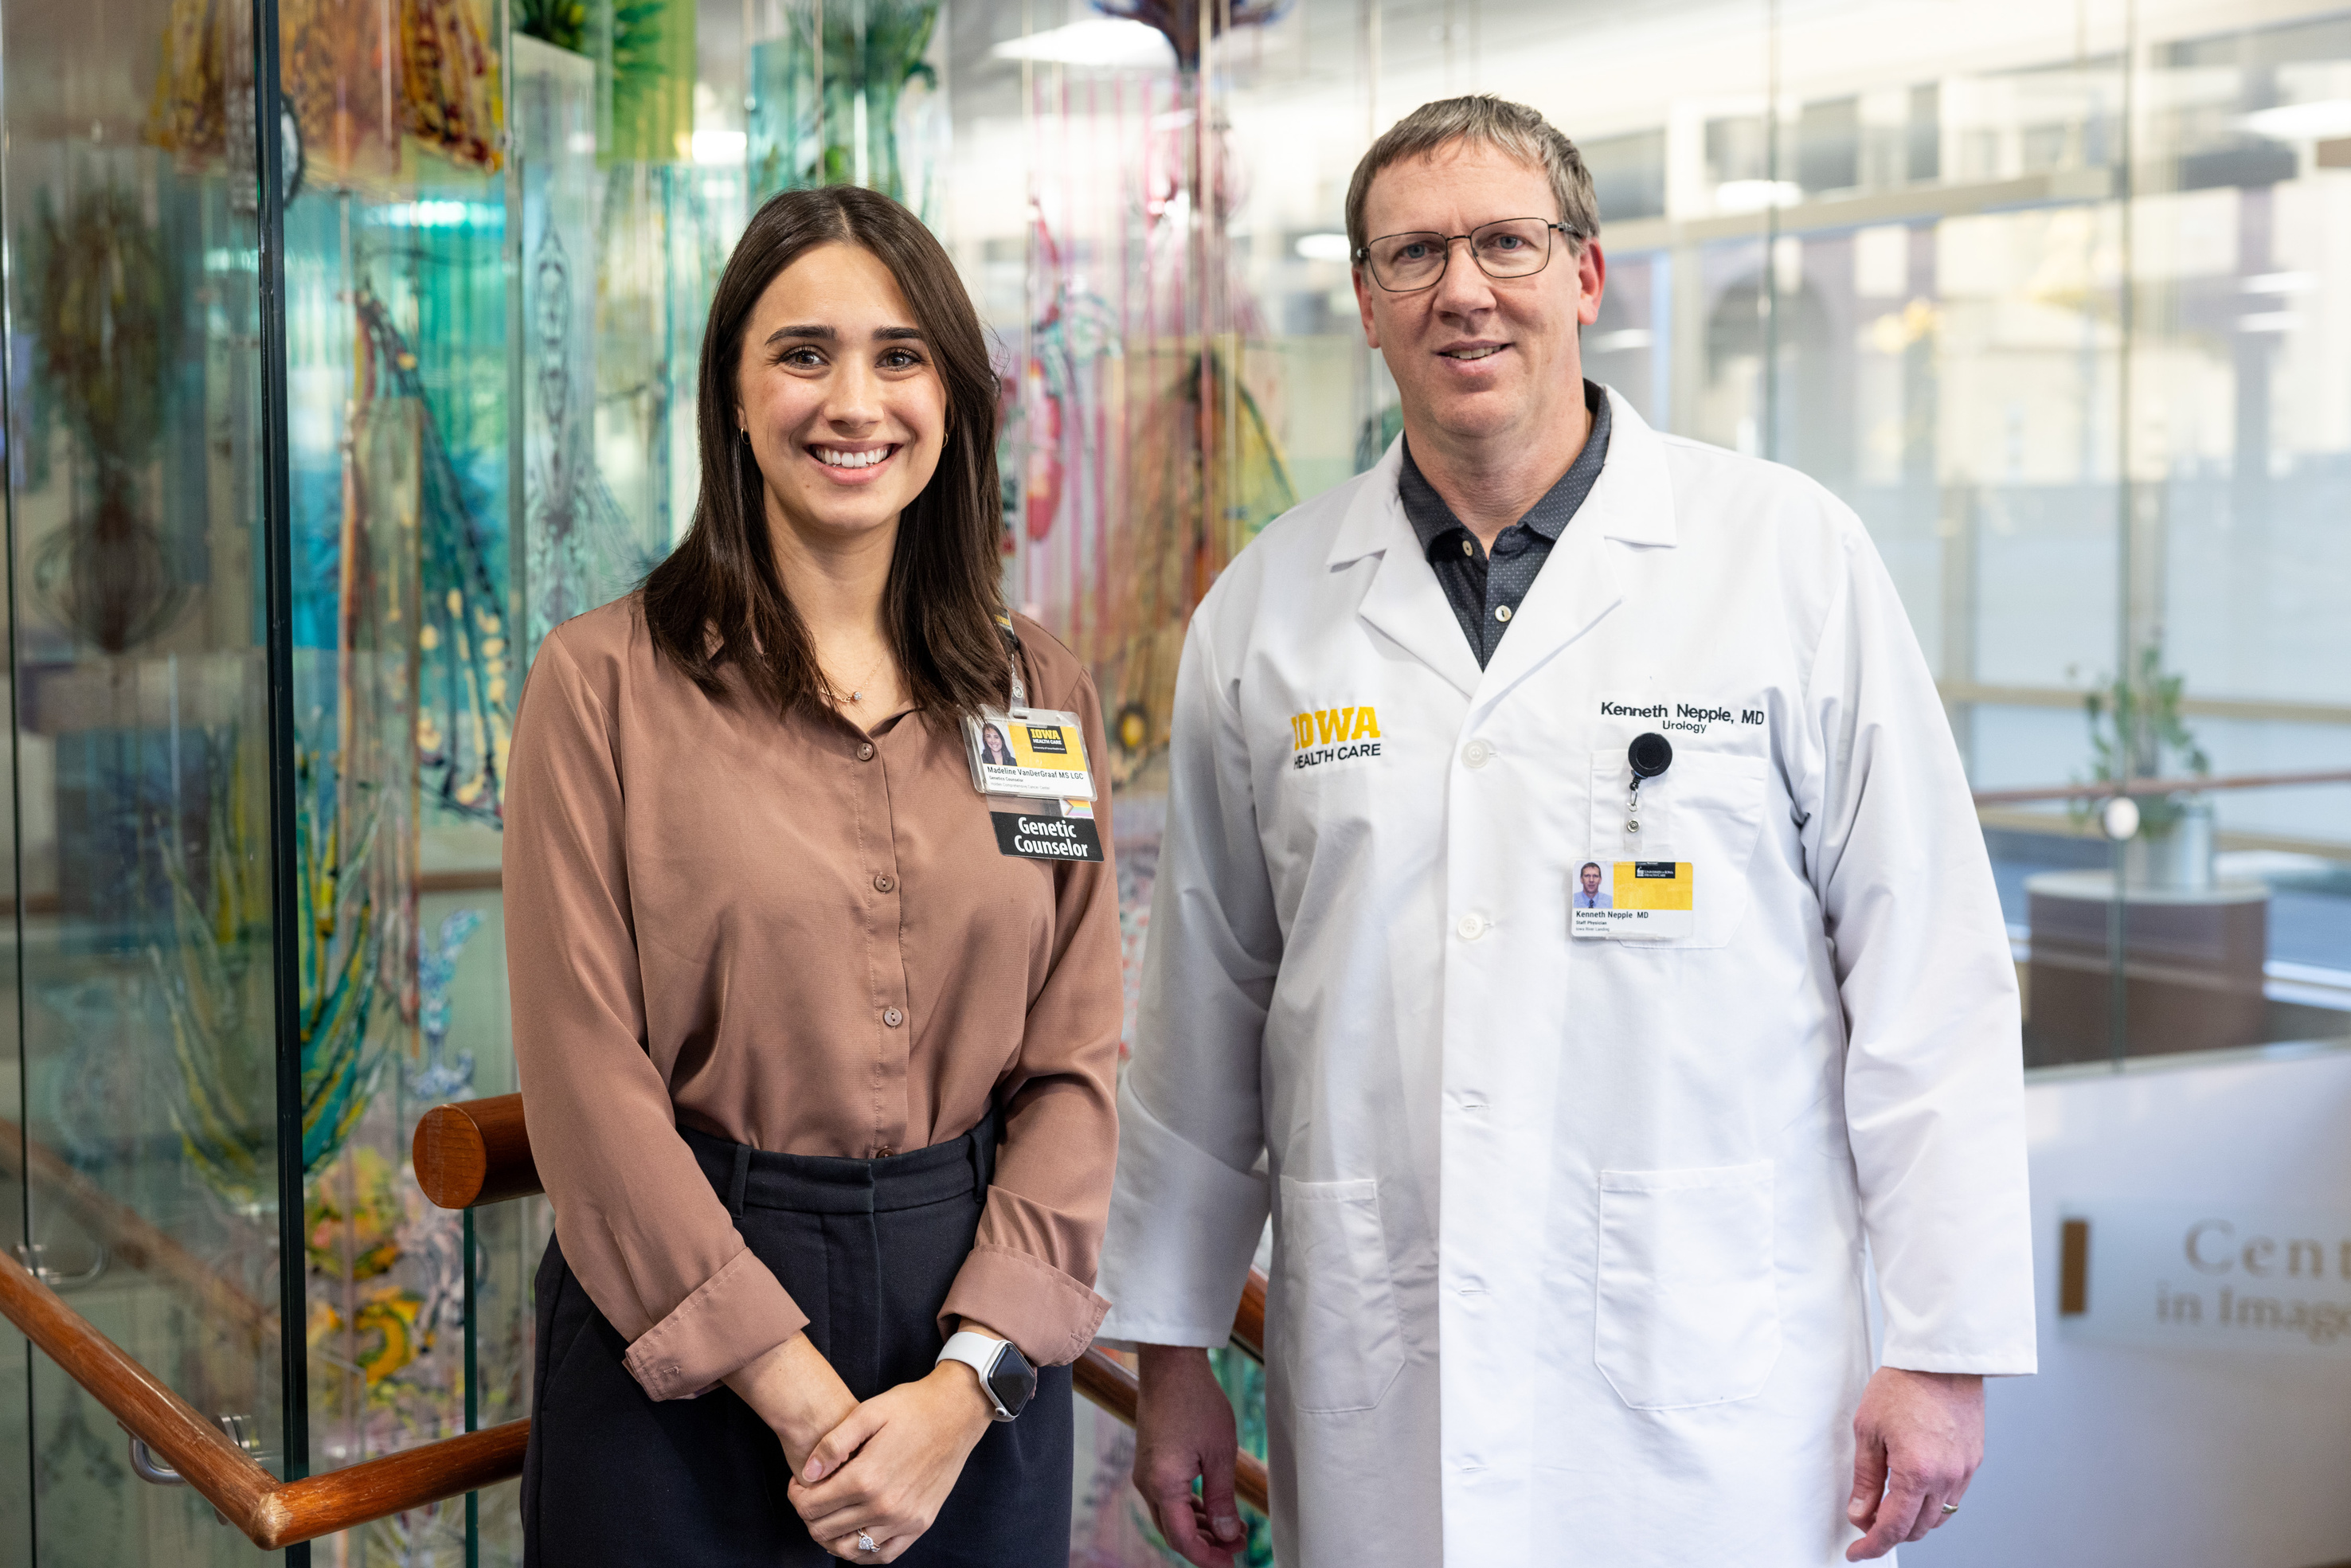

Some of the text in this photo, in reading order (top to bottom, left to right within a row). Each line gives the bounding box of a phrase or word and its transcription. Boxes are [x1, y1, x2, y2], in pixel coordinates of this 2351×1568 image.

[1601, 702, 1765, 725] Kenneth Nepple, MD
[1030, 728, 1061, 740] IOWA
[1291, 706, 1381, 751] IOWA
[1662, 720, 1707, 734] Urology
[1293, 743, 1381, 770] HEALTH CARE
[987, 766, 1016, 775] Madeline
[1018, 768, 1058, 778] VanDerGraaf
[1018, 816, 1077, 838] Genetic
[1014, 835, 1089, 858] Counselor
[1607, 911, 1633, 920] Nepple
